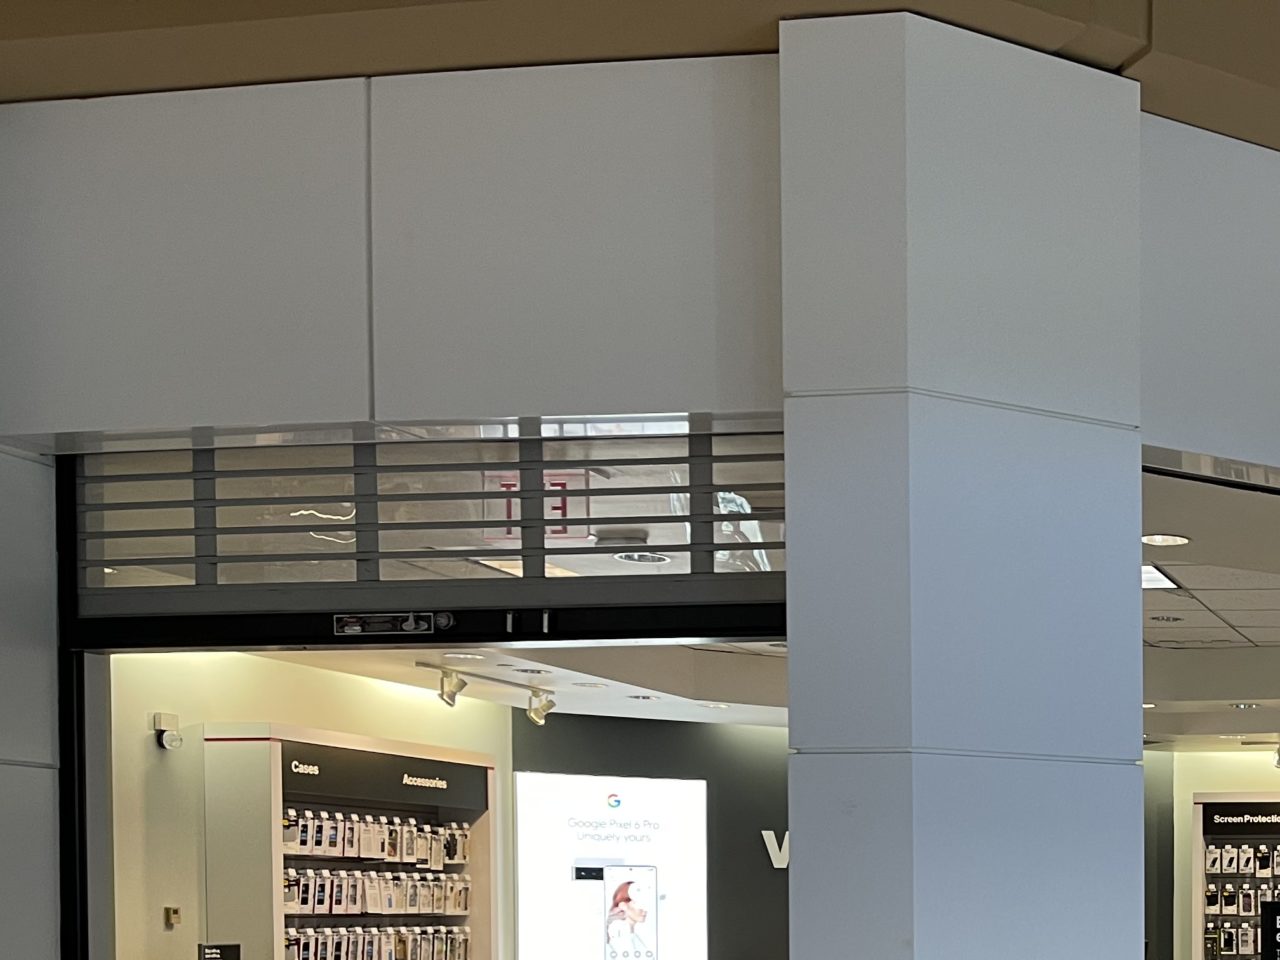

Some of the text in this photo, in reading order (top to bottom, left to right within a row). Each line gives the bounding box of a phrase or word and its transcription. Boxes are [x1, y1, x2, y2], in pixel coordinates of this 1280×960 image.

[291, 760, 320, 775] Cases
[402, 773, 448, 789] Accessories
[567, 817, 607, 831] Google
[643, 819, 660, 830] Pro
[1213, 814, 1243, 823] Screen
